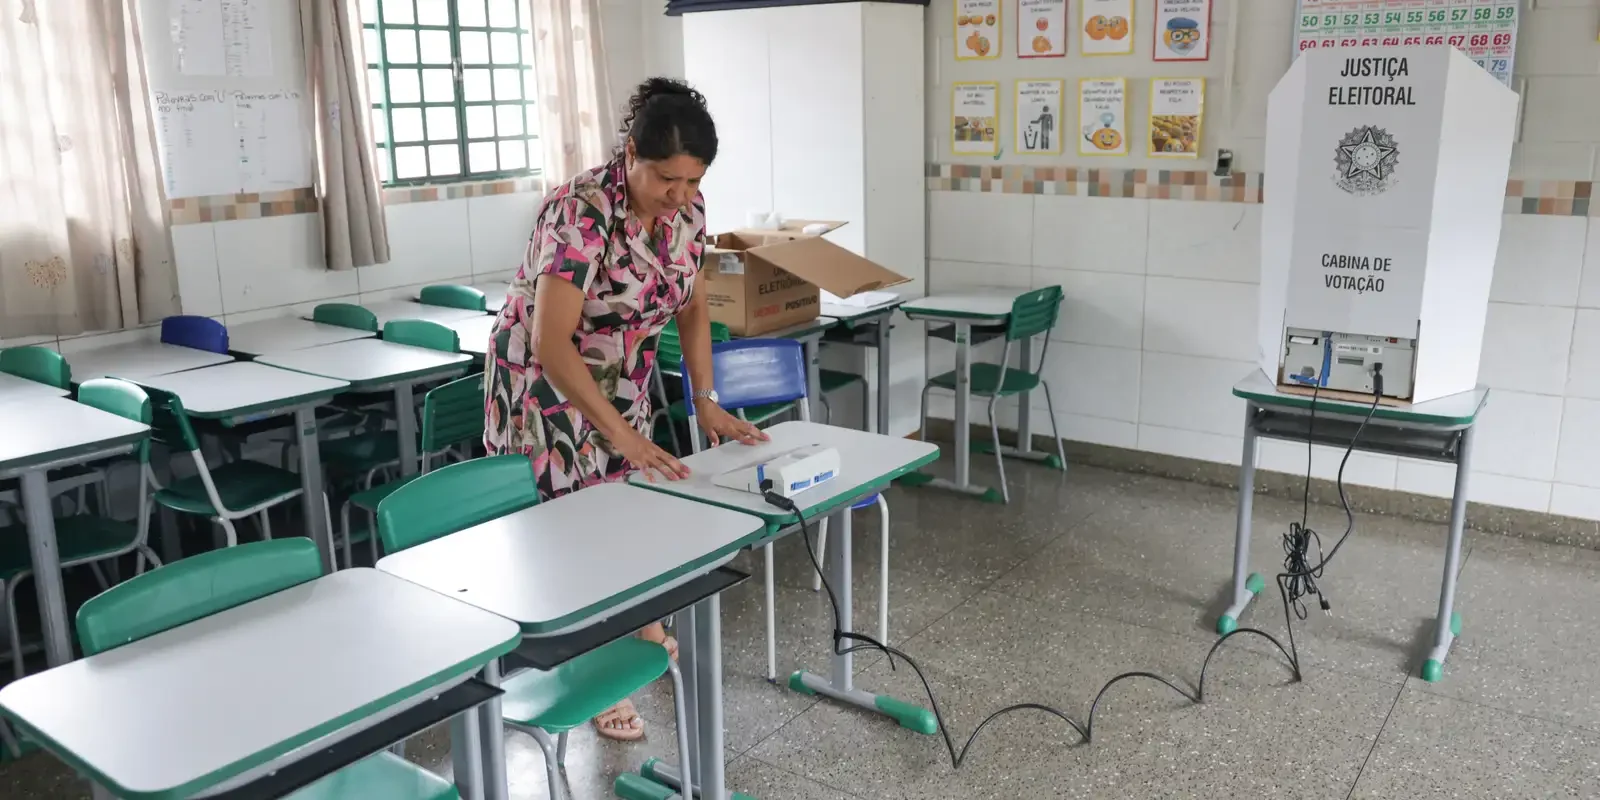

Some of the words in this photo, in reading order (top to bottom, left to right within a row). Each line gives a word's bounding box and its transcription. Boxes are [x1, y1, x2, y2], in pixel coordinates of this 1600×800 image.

[1302, 15, 1318, 27] 50
[1324, 15, 1337, 26] 51
[1343, 14, 1359, 25] 52
[1364, 13, 1380, 24] 53
[1385, 12, 1401, 24] 54
[1407, 11, 1423, 22] 55
[1428, 10, 1445, 22] 56
[1451, 9, 1468, 21] 57
[1474, 8, 1491, 20] 58
[1496, 7, 1514, 19] 59
[1448, 35, 1465, 46] 67
[1470, 34, 1488, 46] 68
[1493, 33, 1511, 45] 69
[1340, 57, 1409, 81] JUSTIÇA
[1491, 60, 1507, 71] 79
[1328, 86, 1416, 106] ELEITORAL
[1321, 253, 1370, 272] CABINA
[1373, 257, 1392, 273] DE
[1325, 273, 1385, 295] VOTAÇÃO
